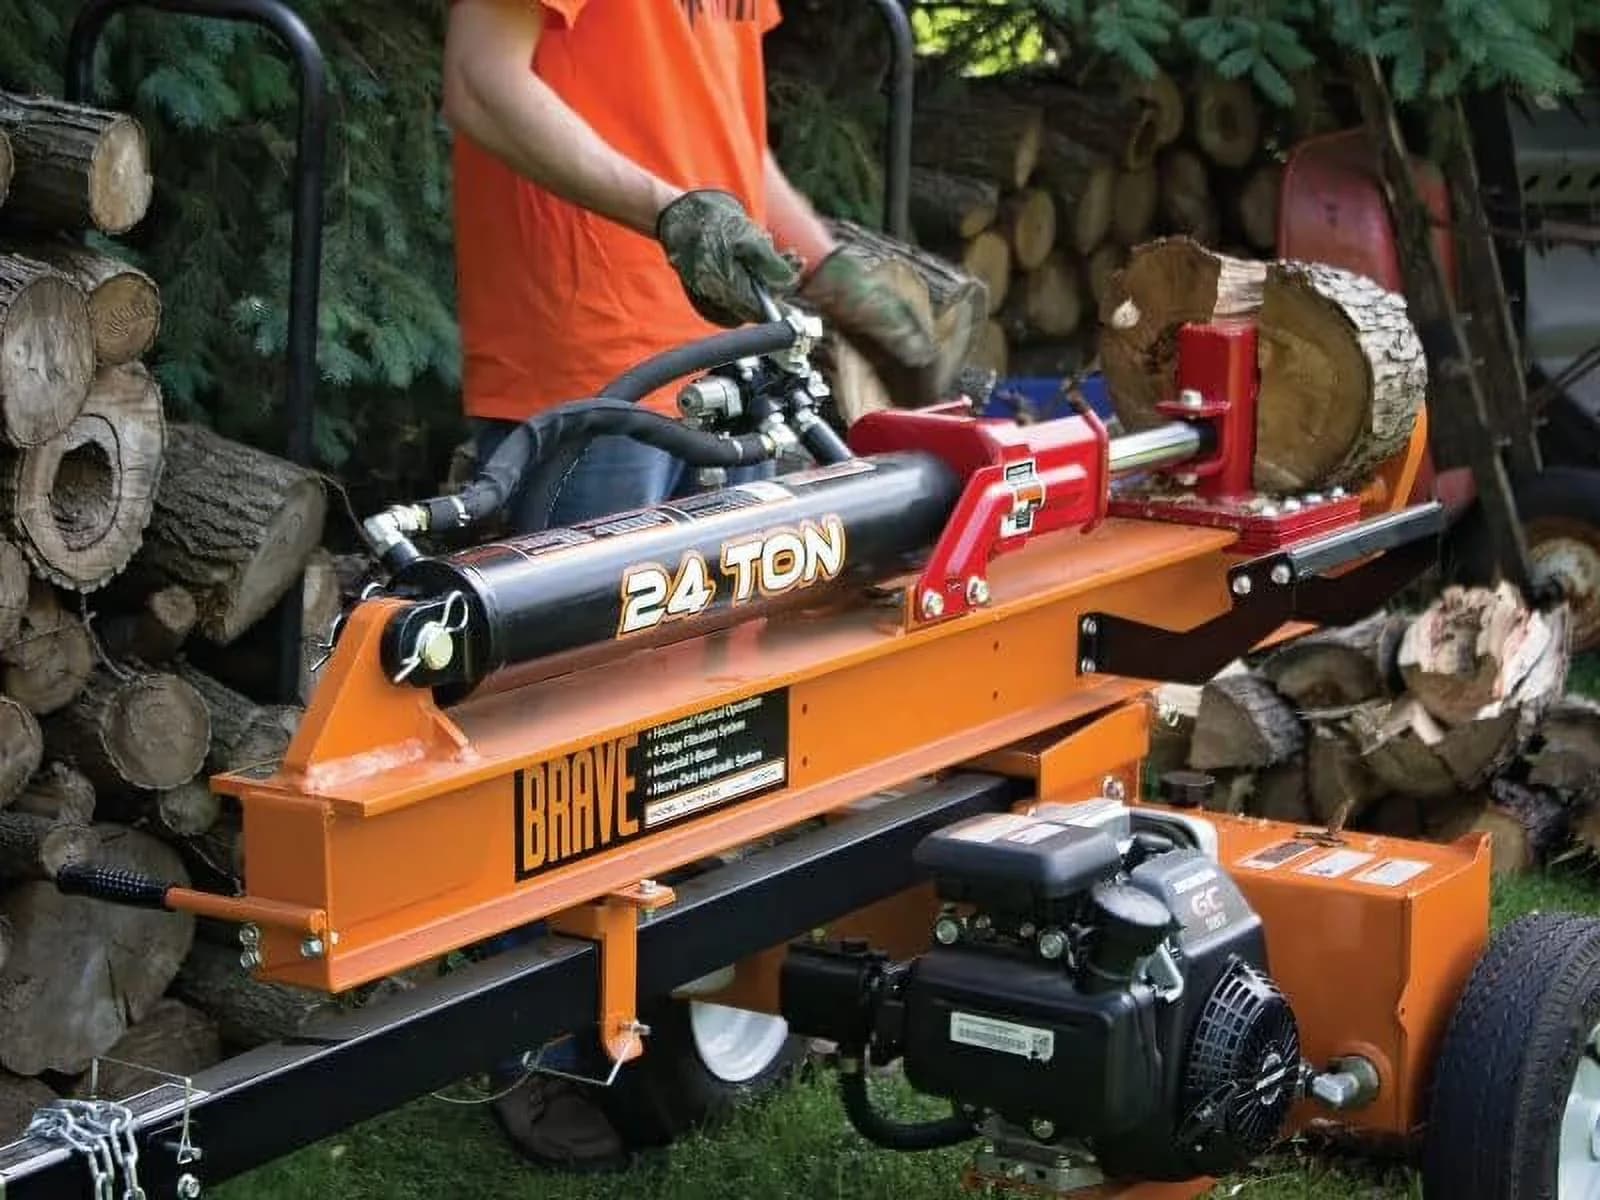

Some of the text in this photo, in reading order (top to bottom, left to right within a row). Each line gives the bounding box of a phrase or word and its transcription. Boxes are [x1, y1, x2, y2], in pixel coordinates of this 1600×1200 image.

[618, 514, 845, 637] 24 TON
[523, 733, 640, 872] BRAVE
